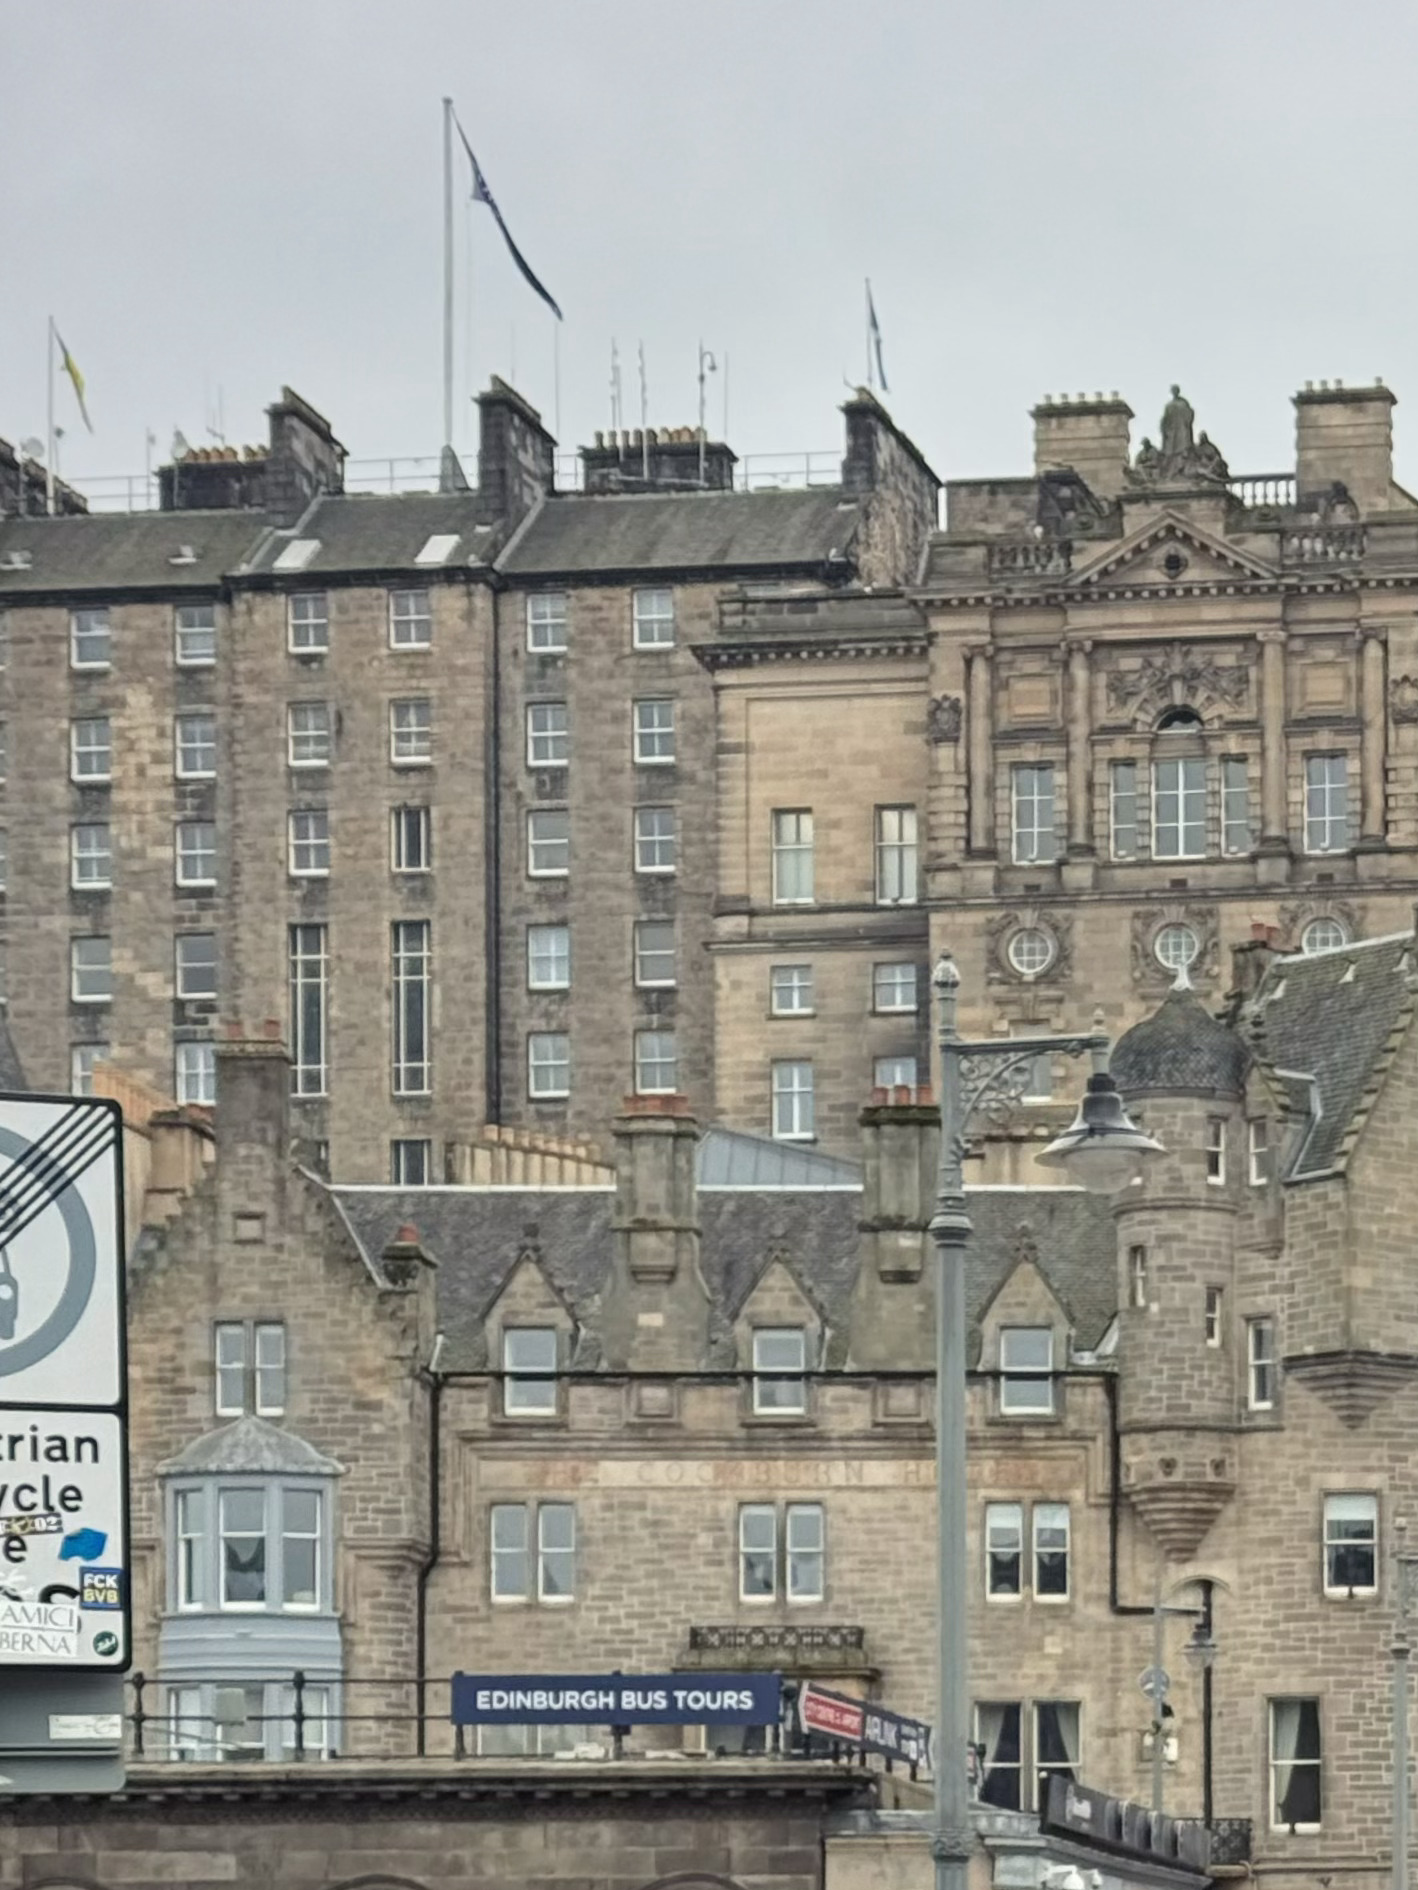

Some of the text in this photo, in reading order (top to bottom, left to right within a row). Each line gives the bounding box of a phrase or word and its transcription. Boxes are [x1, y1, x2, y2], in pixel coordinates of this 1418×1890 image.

[83, 1573, 119, 1589] FCK
[475, 1690, 754, 1710] EDINBURGH BUS TOURS
